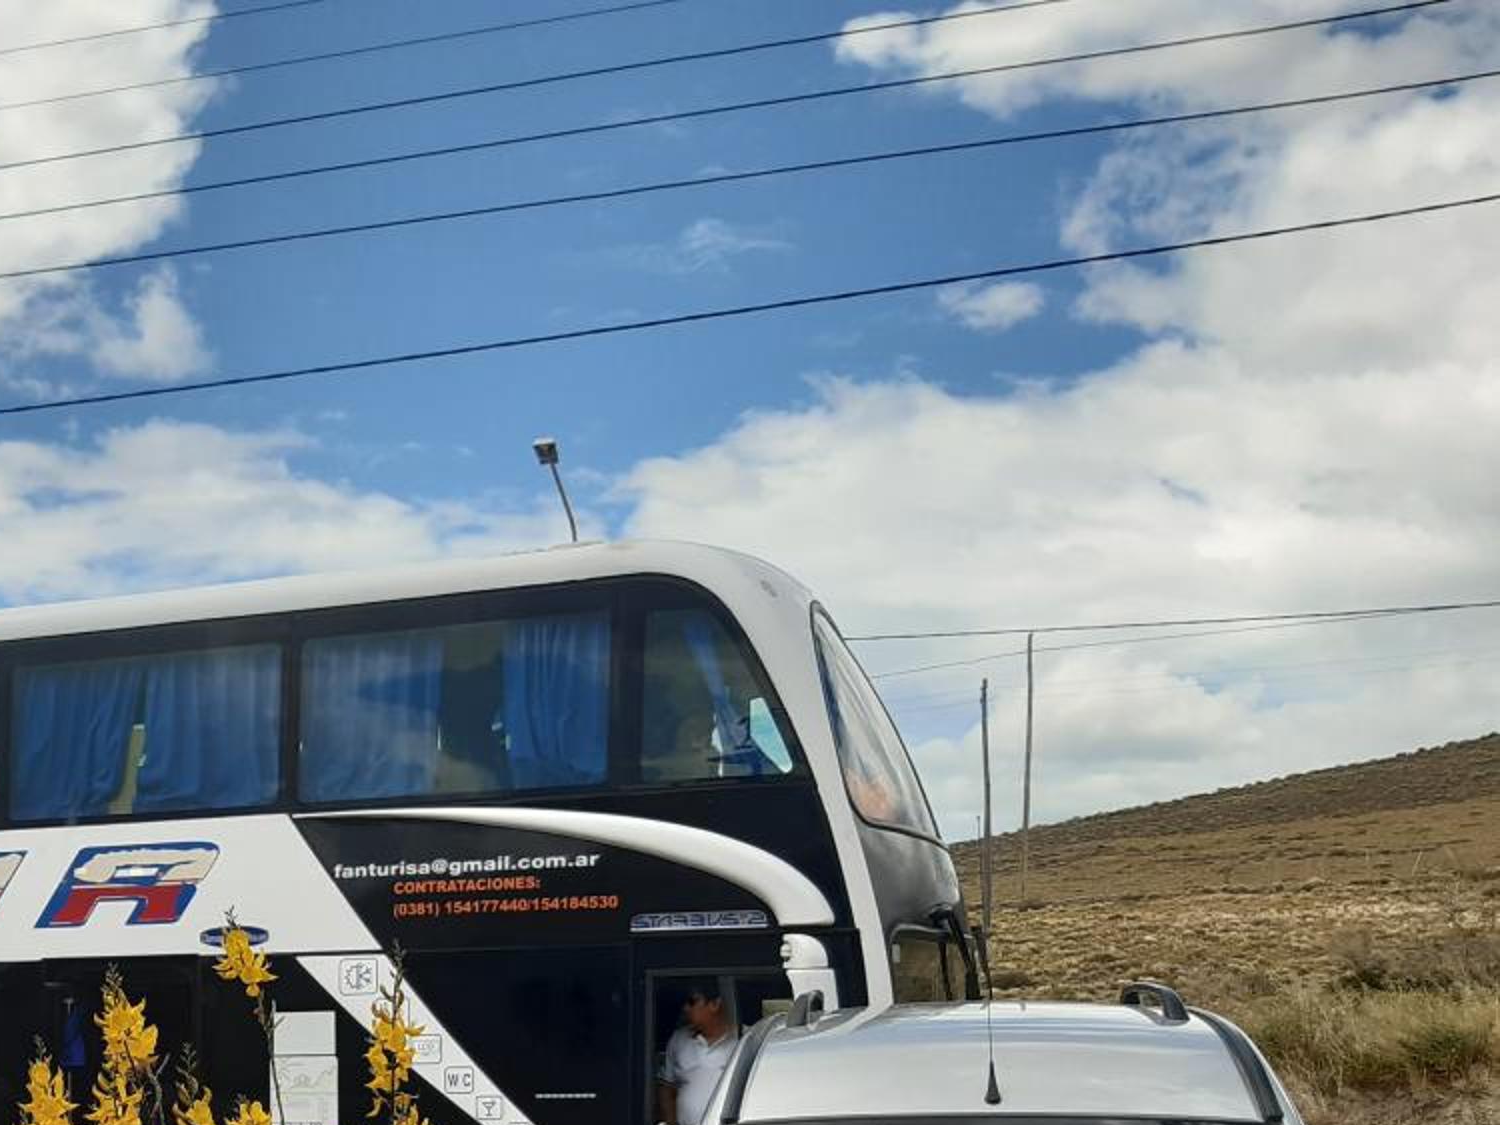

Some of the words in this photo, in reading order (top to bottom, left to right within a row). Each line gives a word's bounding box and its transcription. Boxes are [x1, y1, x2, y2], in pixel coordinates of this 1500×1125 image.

[334, 853, 600, 879] fanturisa@gmail.com.ar
[393, 876, 540, 895] CONTRATACIONES:
[393, 903, 439, 919] (0381)
